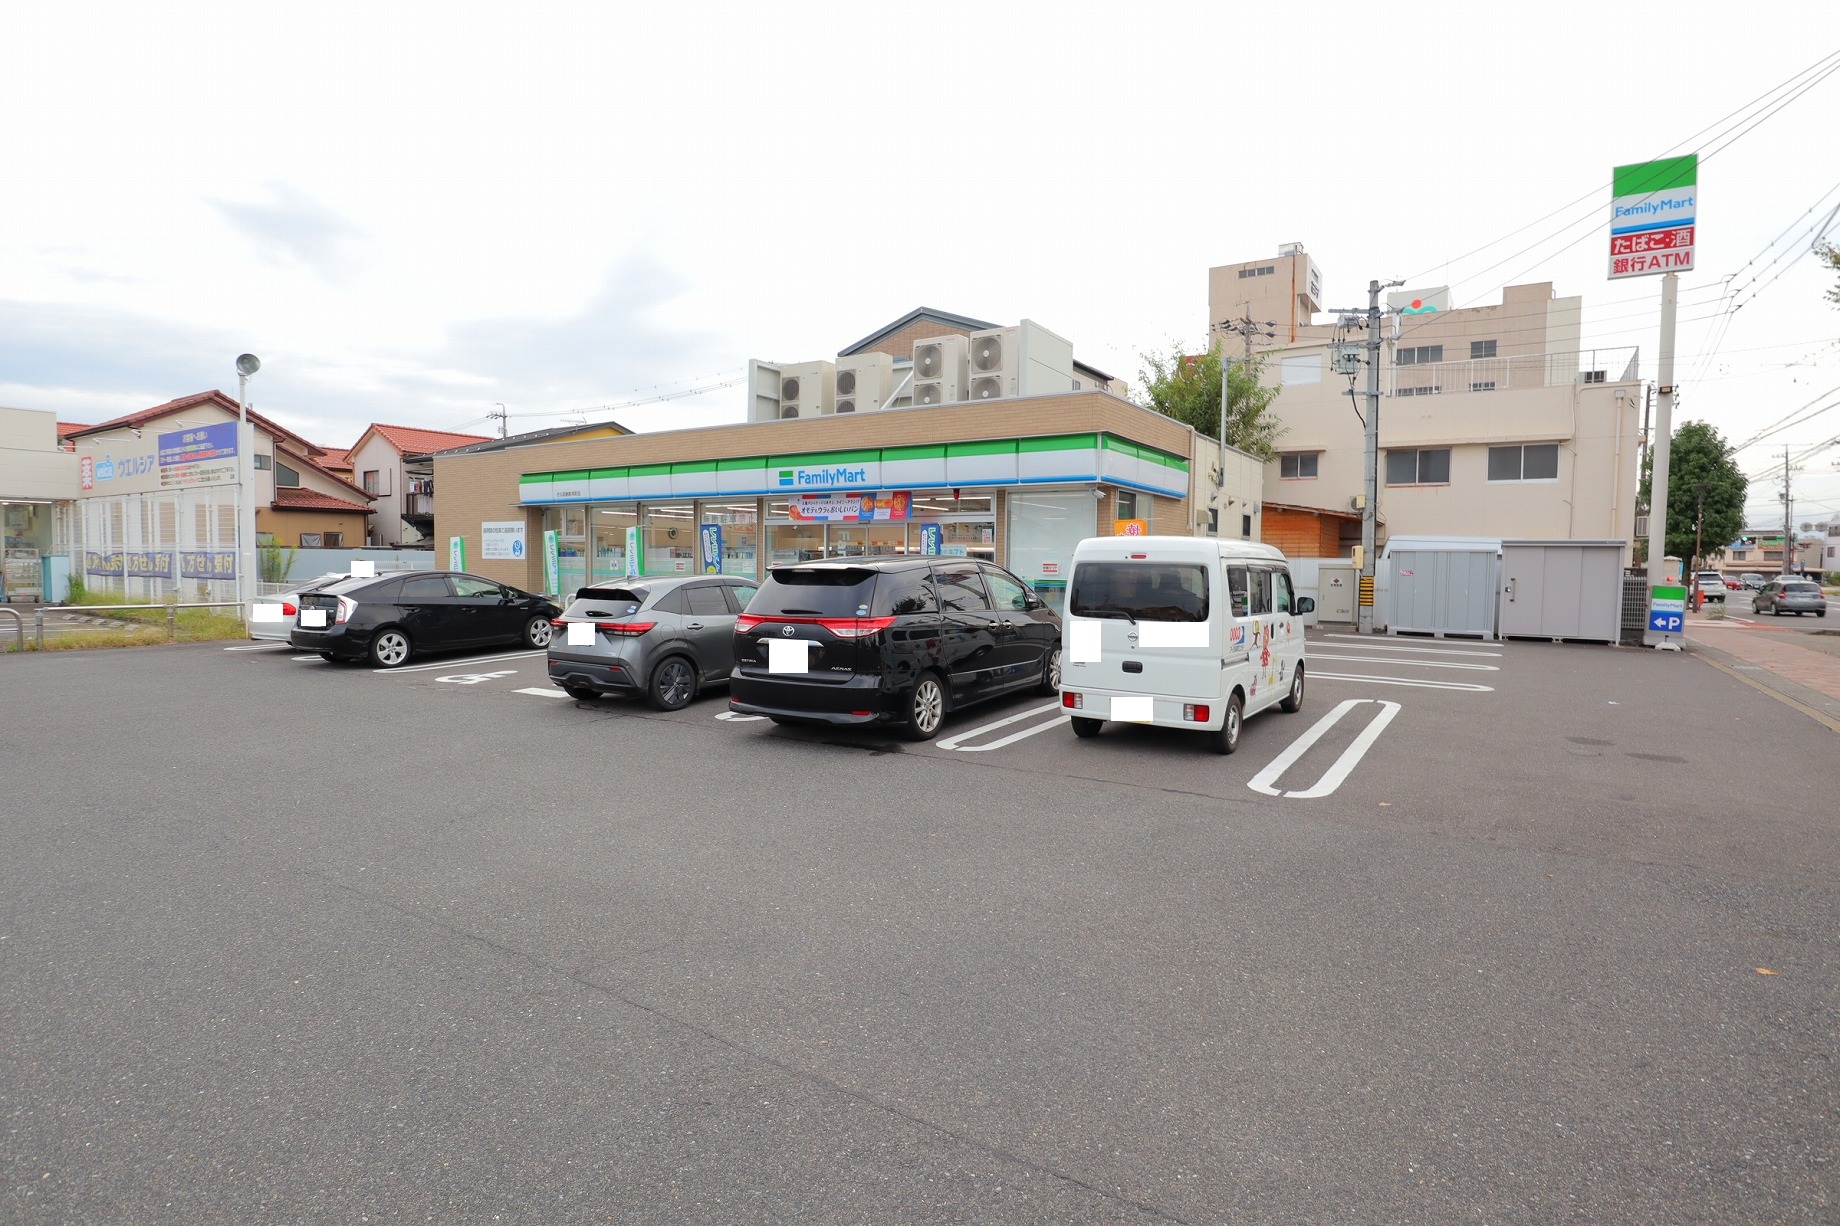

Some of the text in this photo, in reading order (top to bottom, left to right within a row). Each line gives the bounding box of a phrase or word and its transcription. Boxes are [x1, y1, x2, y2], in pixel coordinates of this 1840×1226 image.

[1615, 197, 1694, 217] FamilyMart
[1614, 230, 1691, 253] たばこ・酒
[1614, 251, 1690, 273] 銀行ATM
[118, 454, 155, 477] ウエルシア
[798, 468, 865, 485] FamilyMart
[1668, 616, 1680, 630] P
